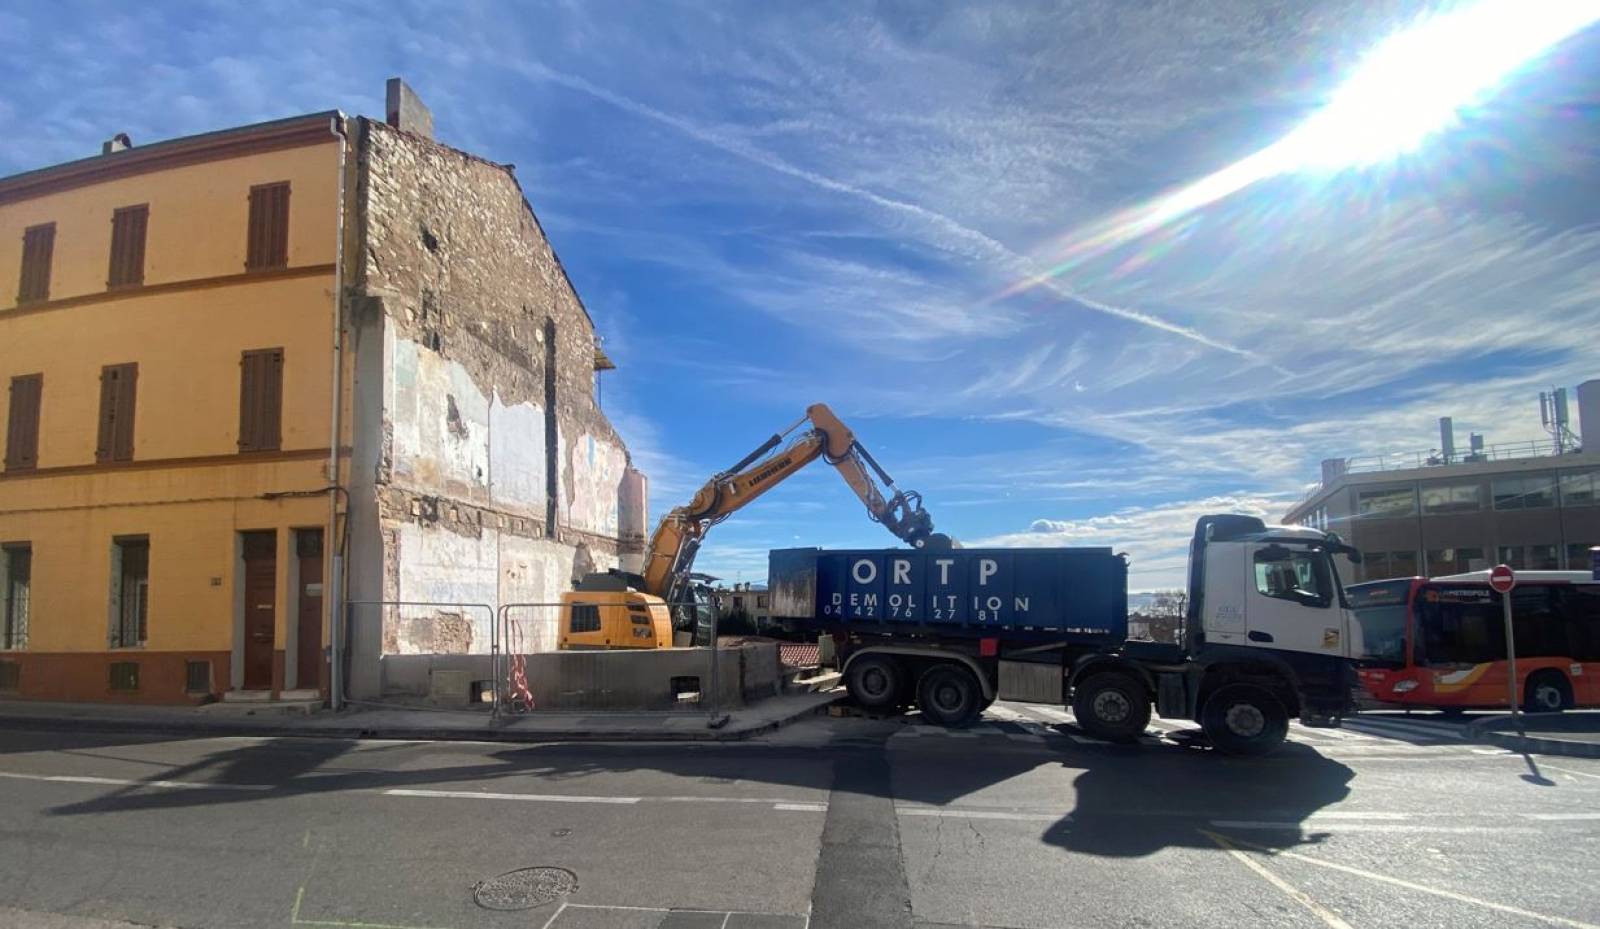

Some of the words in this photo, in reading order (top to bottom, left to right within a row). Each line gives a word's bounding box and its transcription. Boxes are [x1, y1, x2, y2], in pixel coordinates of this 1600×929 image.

[852, 559, 998, 585] ORTP
[832, 593, 1029, 611] DEMOLITION
[824, 605, 842, 616] 04
[855, 606, 874, 617] 42
[892, 607, 913, 618] 76
[934, 609, 957, 620] 27
[978, 610, 999, 621] 81
